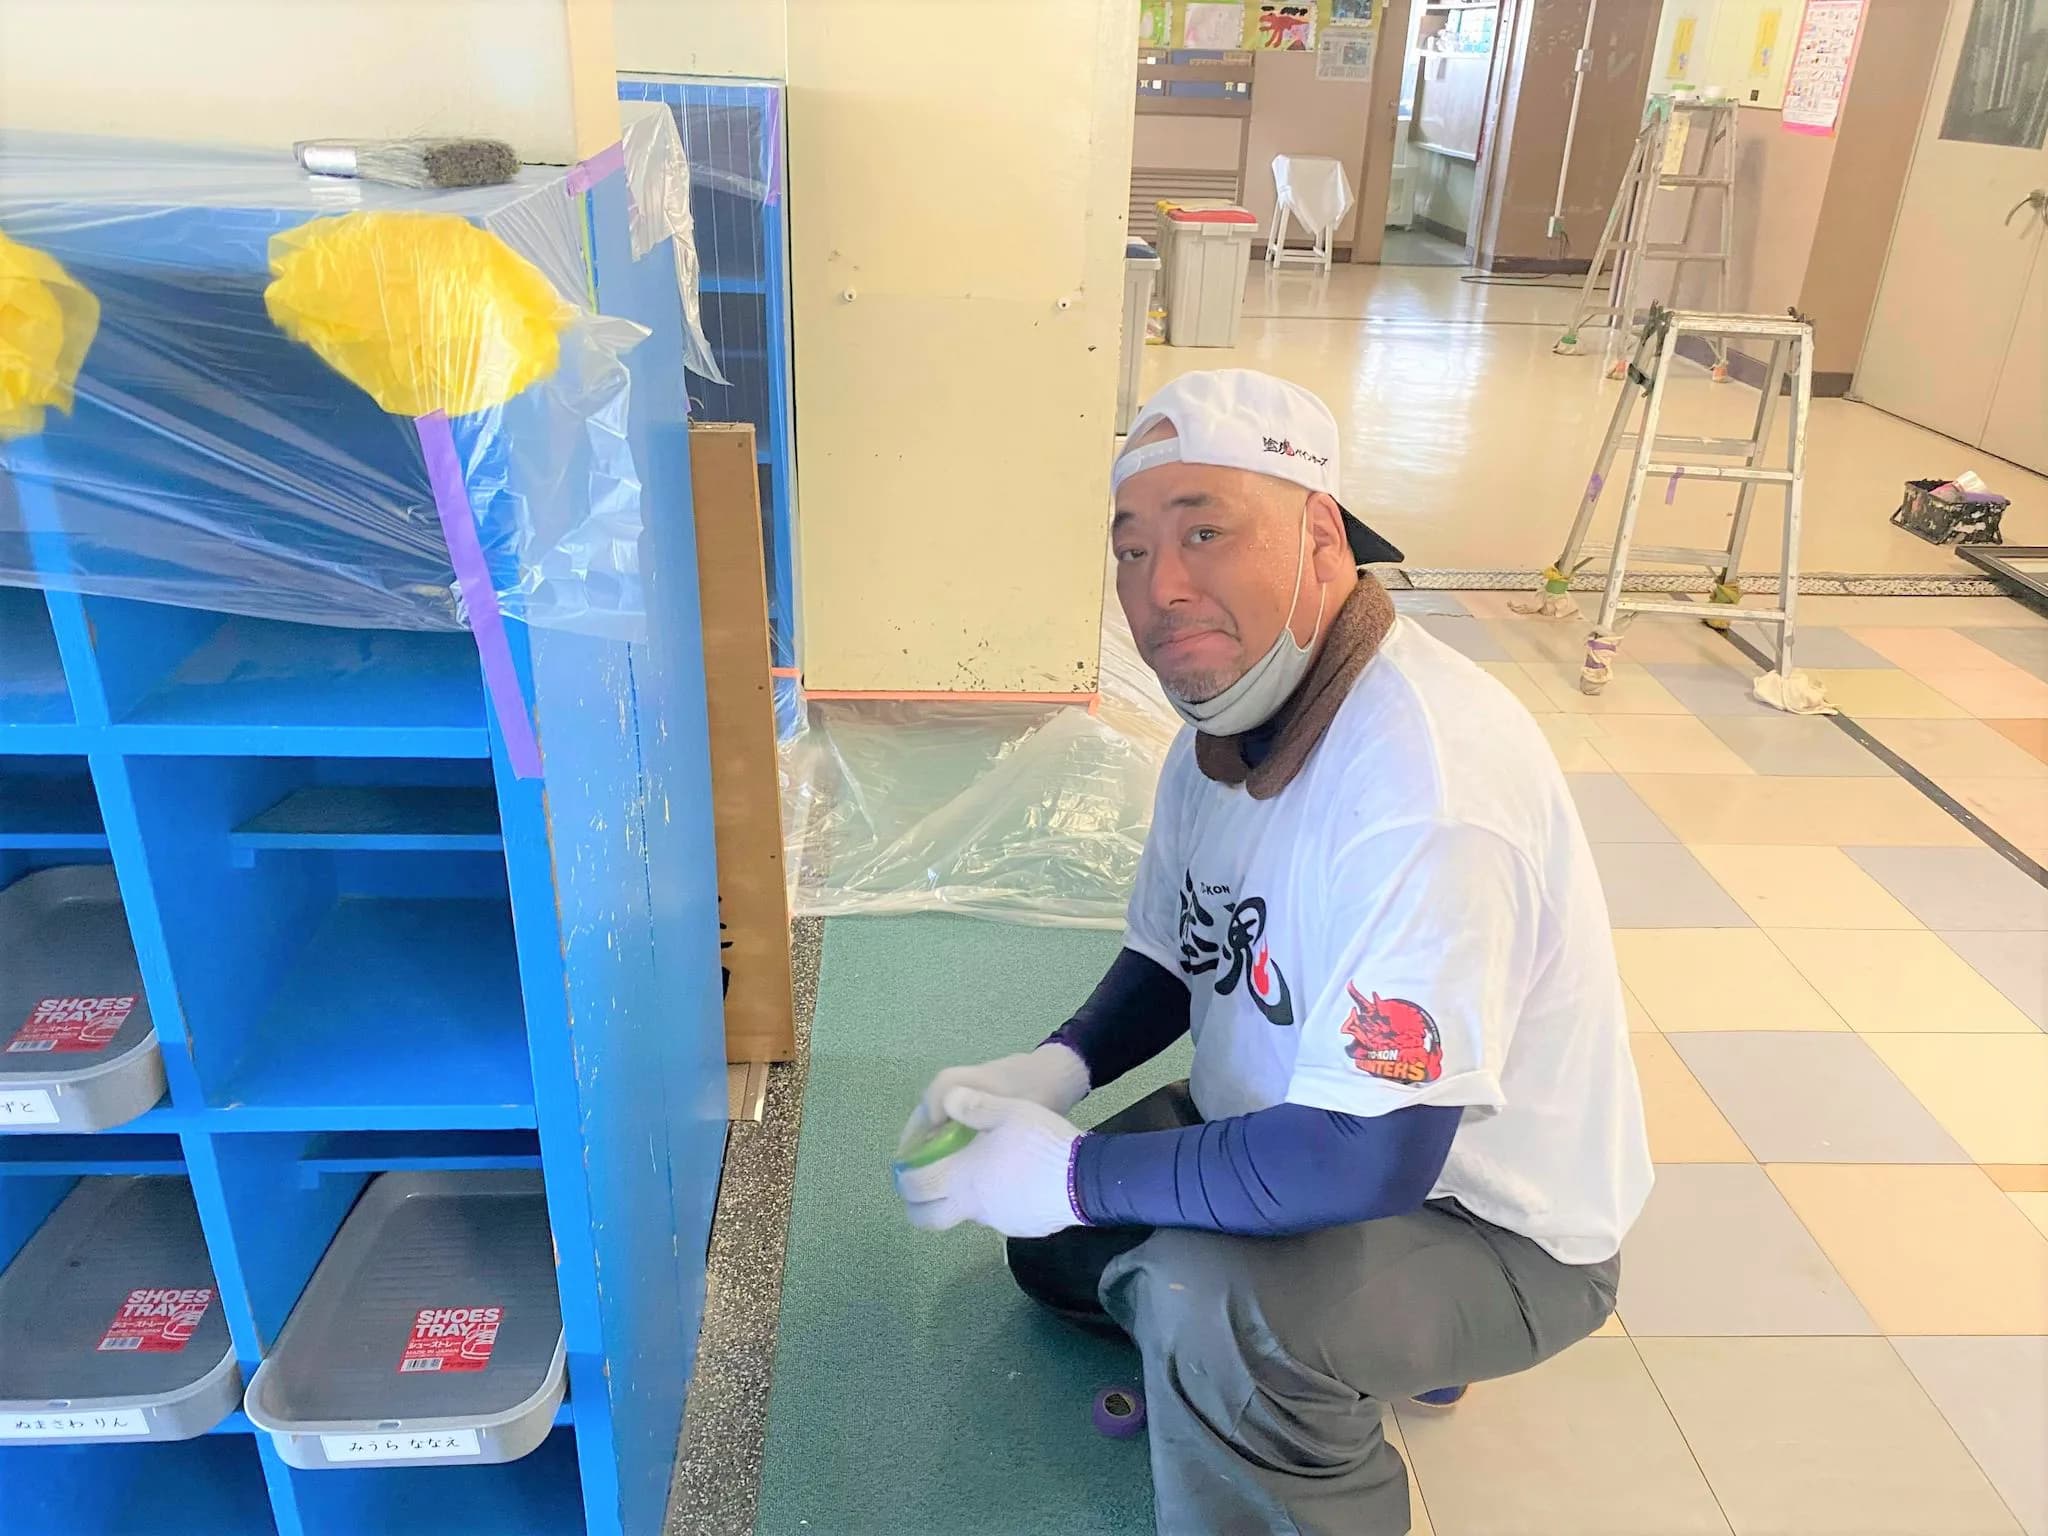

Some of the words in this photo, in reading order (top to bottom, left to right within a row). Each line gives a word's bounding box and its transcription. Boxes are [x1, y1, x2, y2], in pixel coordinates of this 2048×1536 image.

[39, 998, 134, 1011] SHOES
[33, 1011, 101, 1024] TRAY
[128, 1290, 211, 1304] SHOES
[121, 1303, 183, 1317] TRAY
[417, 1308, 500, 1324] SHOES
[416, 1324, 474, 1338] TRAY
[349, 1440, 399, 1452] みうら
